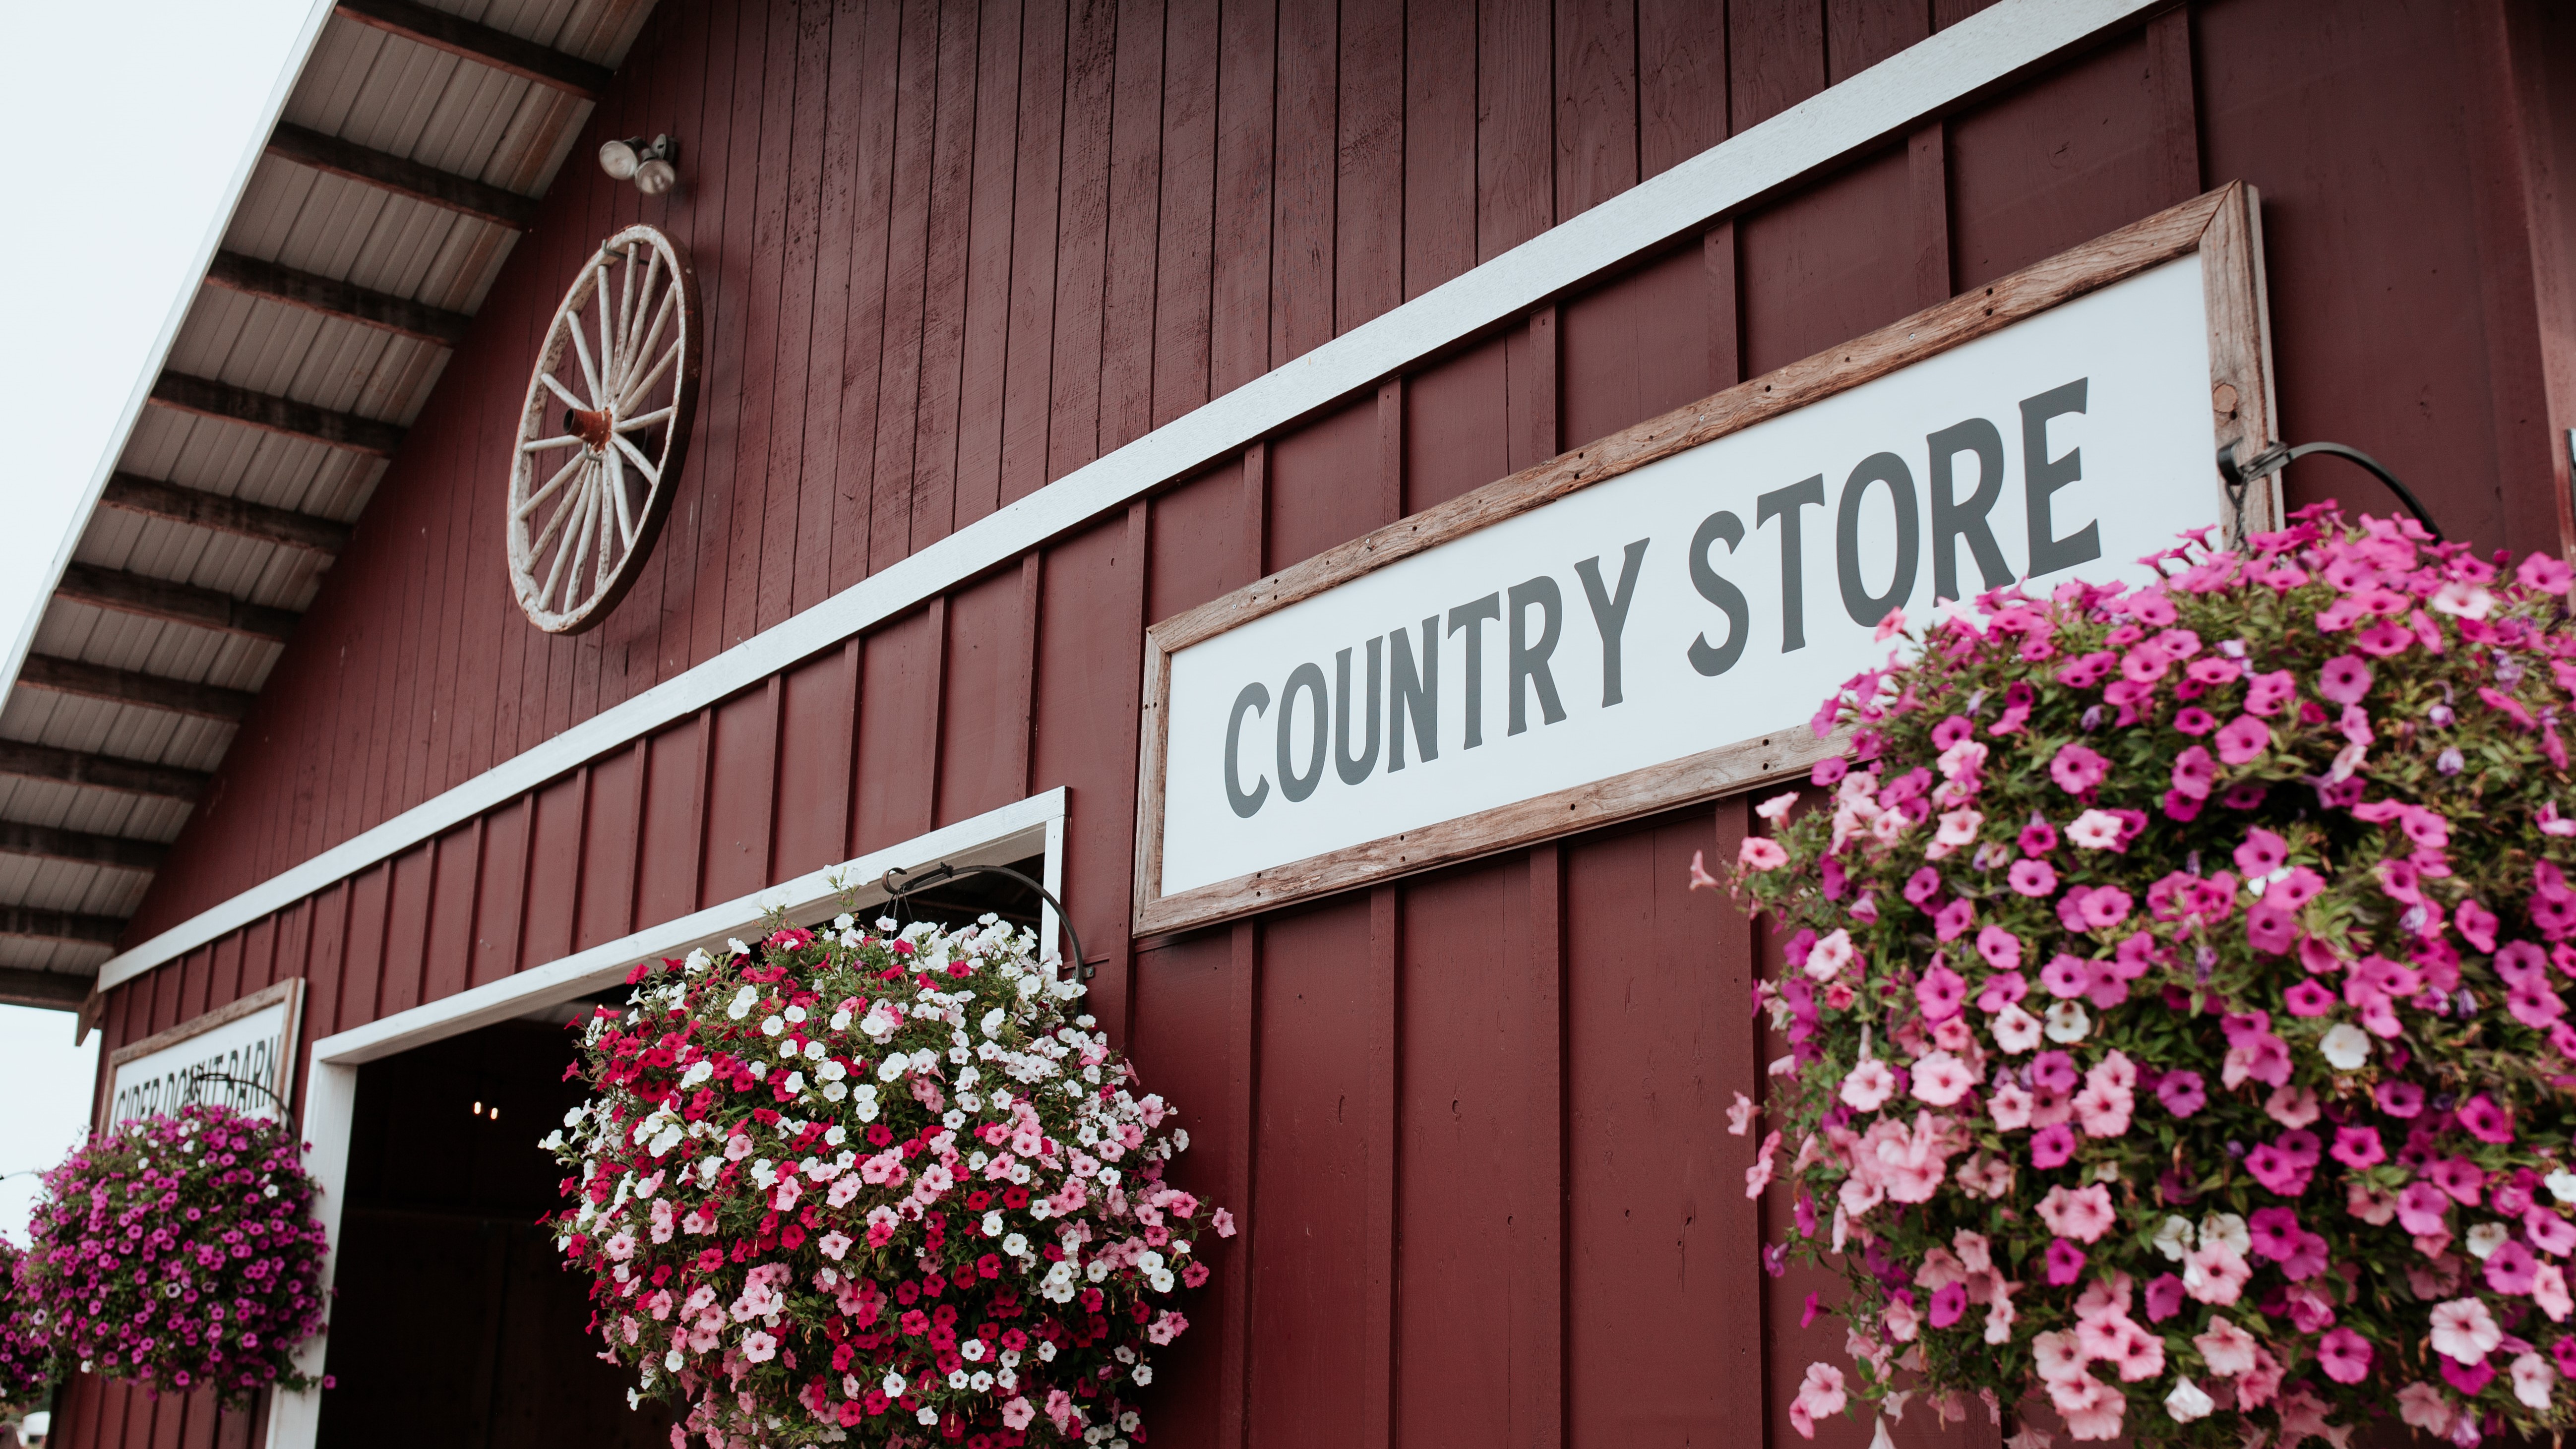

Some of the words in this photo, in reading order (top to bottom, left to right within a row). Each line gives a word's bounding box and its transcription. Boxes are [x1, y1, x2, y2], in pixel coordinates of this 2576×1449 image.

[1225, 538, 1650, 818] COUNTRY
[1687, 377, 2101, 676] STORE
[114, 1078, 160, 1129] CIDER
[224, 1034, 281, 1112] BARN
